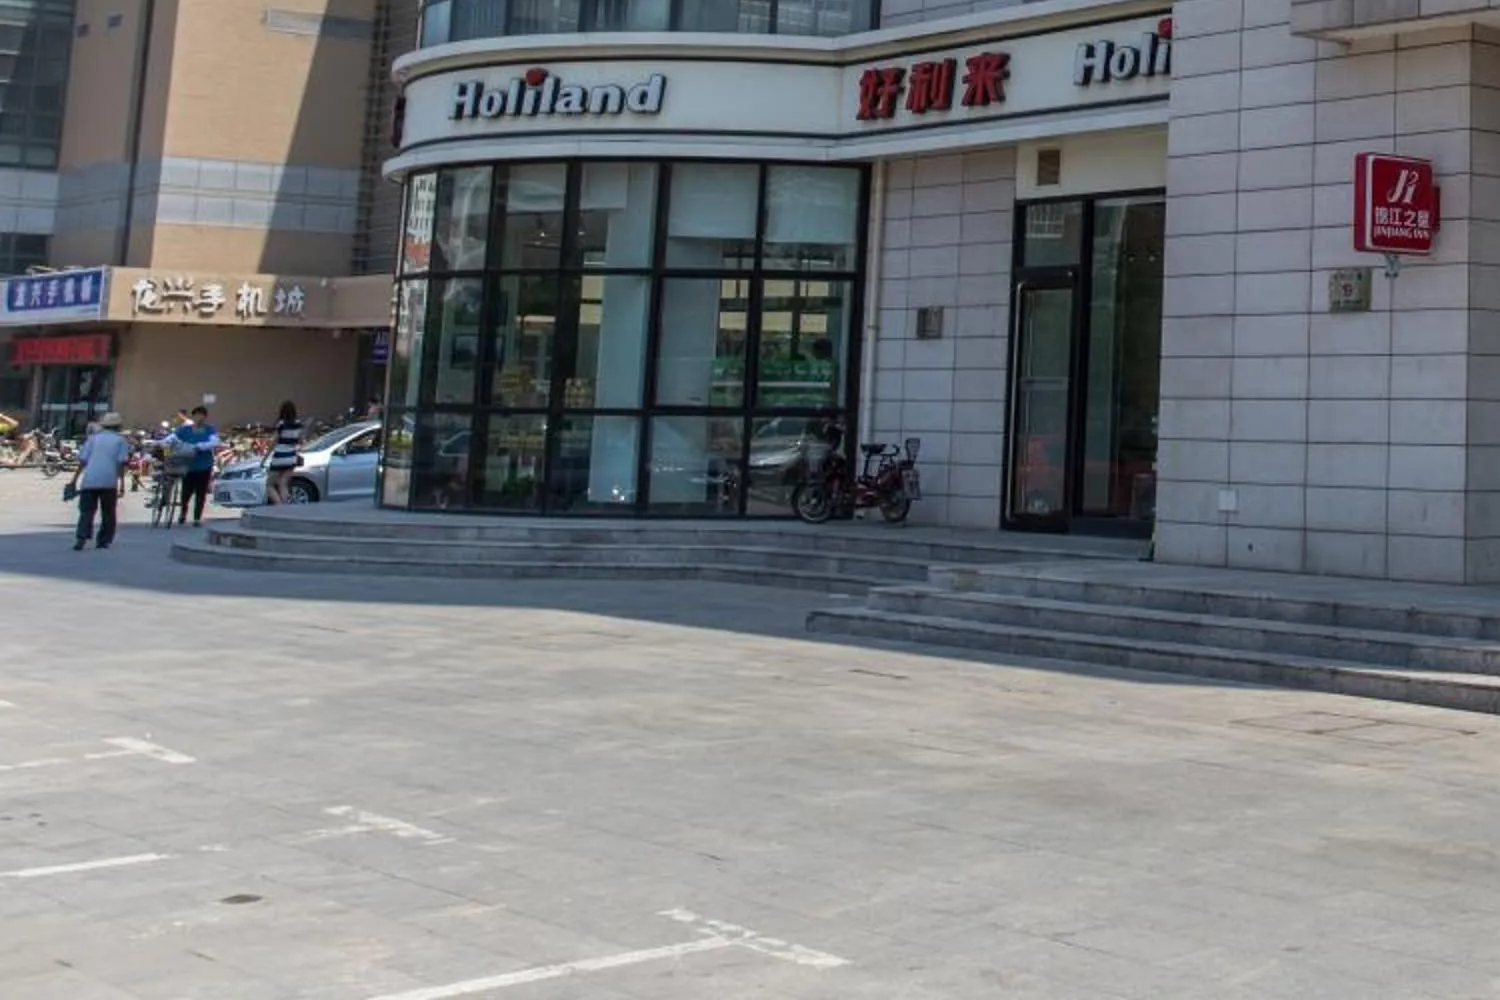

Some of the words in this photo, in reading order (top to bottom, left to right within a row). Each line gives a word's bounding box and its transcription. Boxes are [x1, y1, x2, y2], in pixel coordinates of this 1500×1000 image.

[449, 67, 667, 120] Holiland
[856, 52, 1010, 120] 好利来
[1375, 205, 1430, 229] 锦江之星
